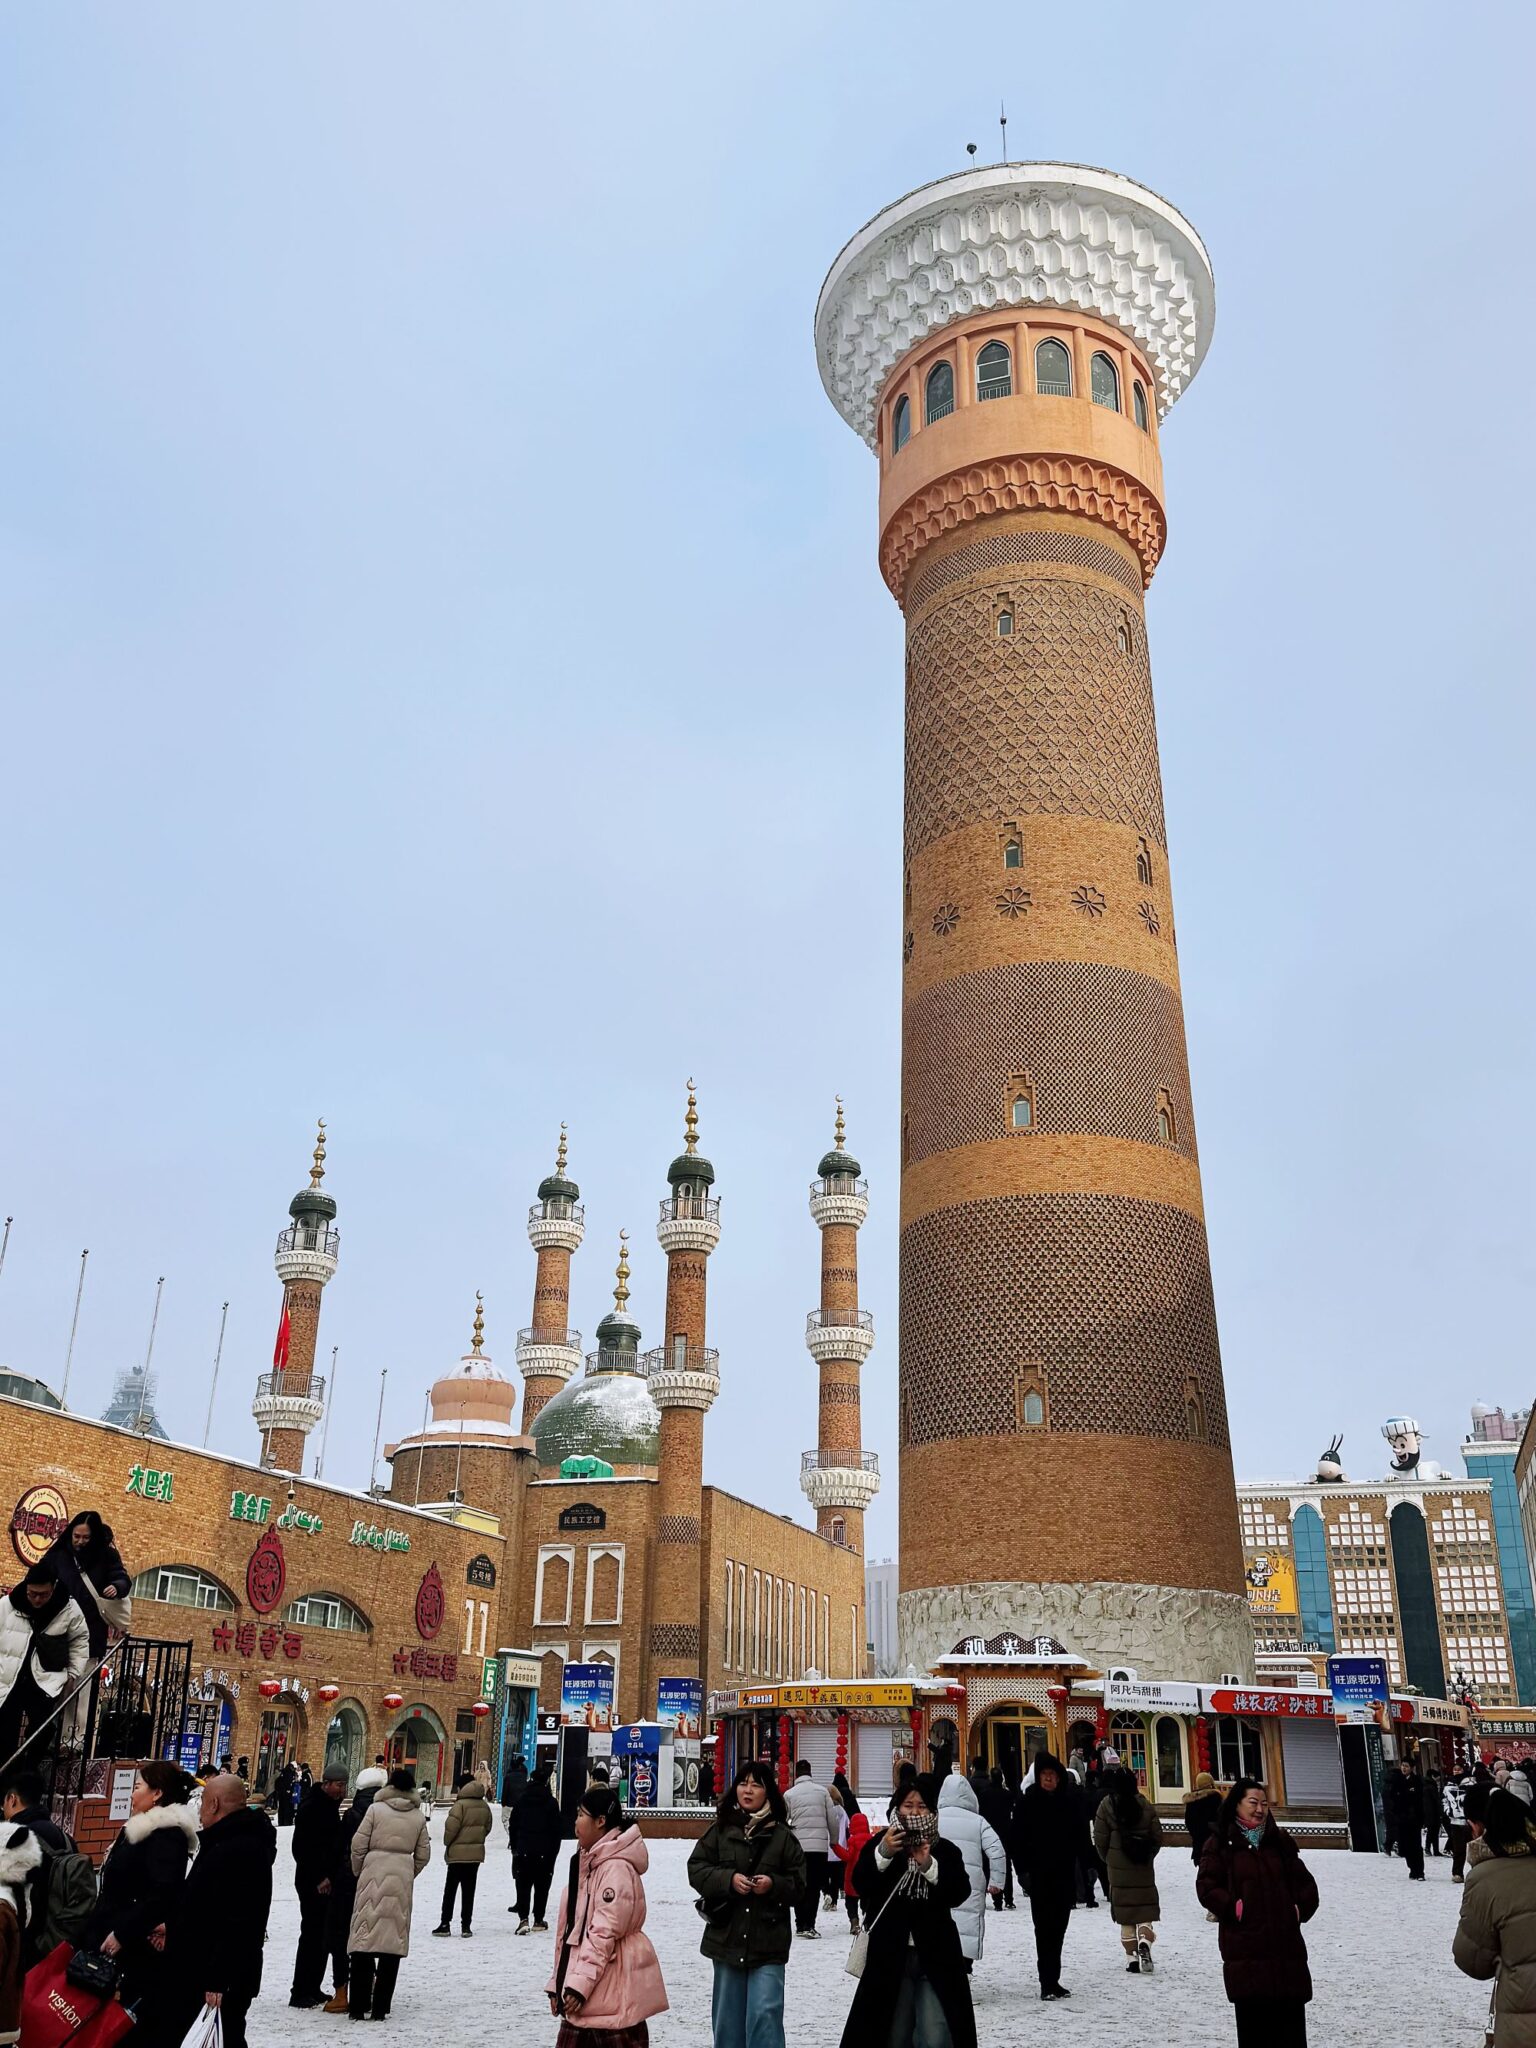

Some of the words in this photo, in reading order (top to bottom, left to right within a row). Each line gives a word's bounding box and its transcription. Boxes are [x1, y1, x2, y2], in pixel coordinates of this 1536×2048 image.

[126, 1463, 174, 1502] 大巴扎
[229, 1490, 272, 1524] 宴会厅
[212, 1620, 304, 1659] 大漠奇石
[964, 1637, 1053, 1656] 观光塔
[485, 1670, 495, 1692] 5
[564, 1680, 596, 1689] 旺源驼奶
[1334, 1674, 1381, 1685] 旺源驼奶
[660, 1691, 688, 1700] 旺源驼奶
[1110, 1684, 1162, 1697] 阿凡与甜甜
